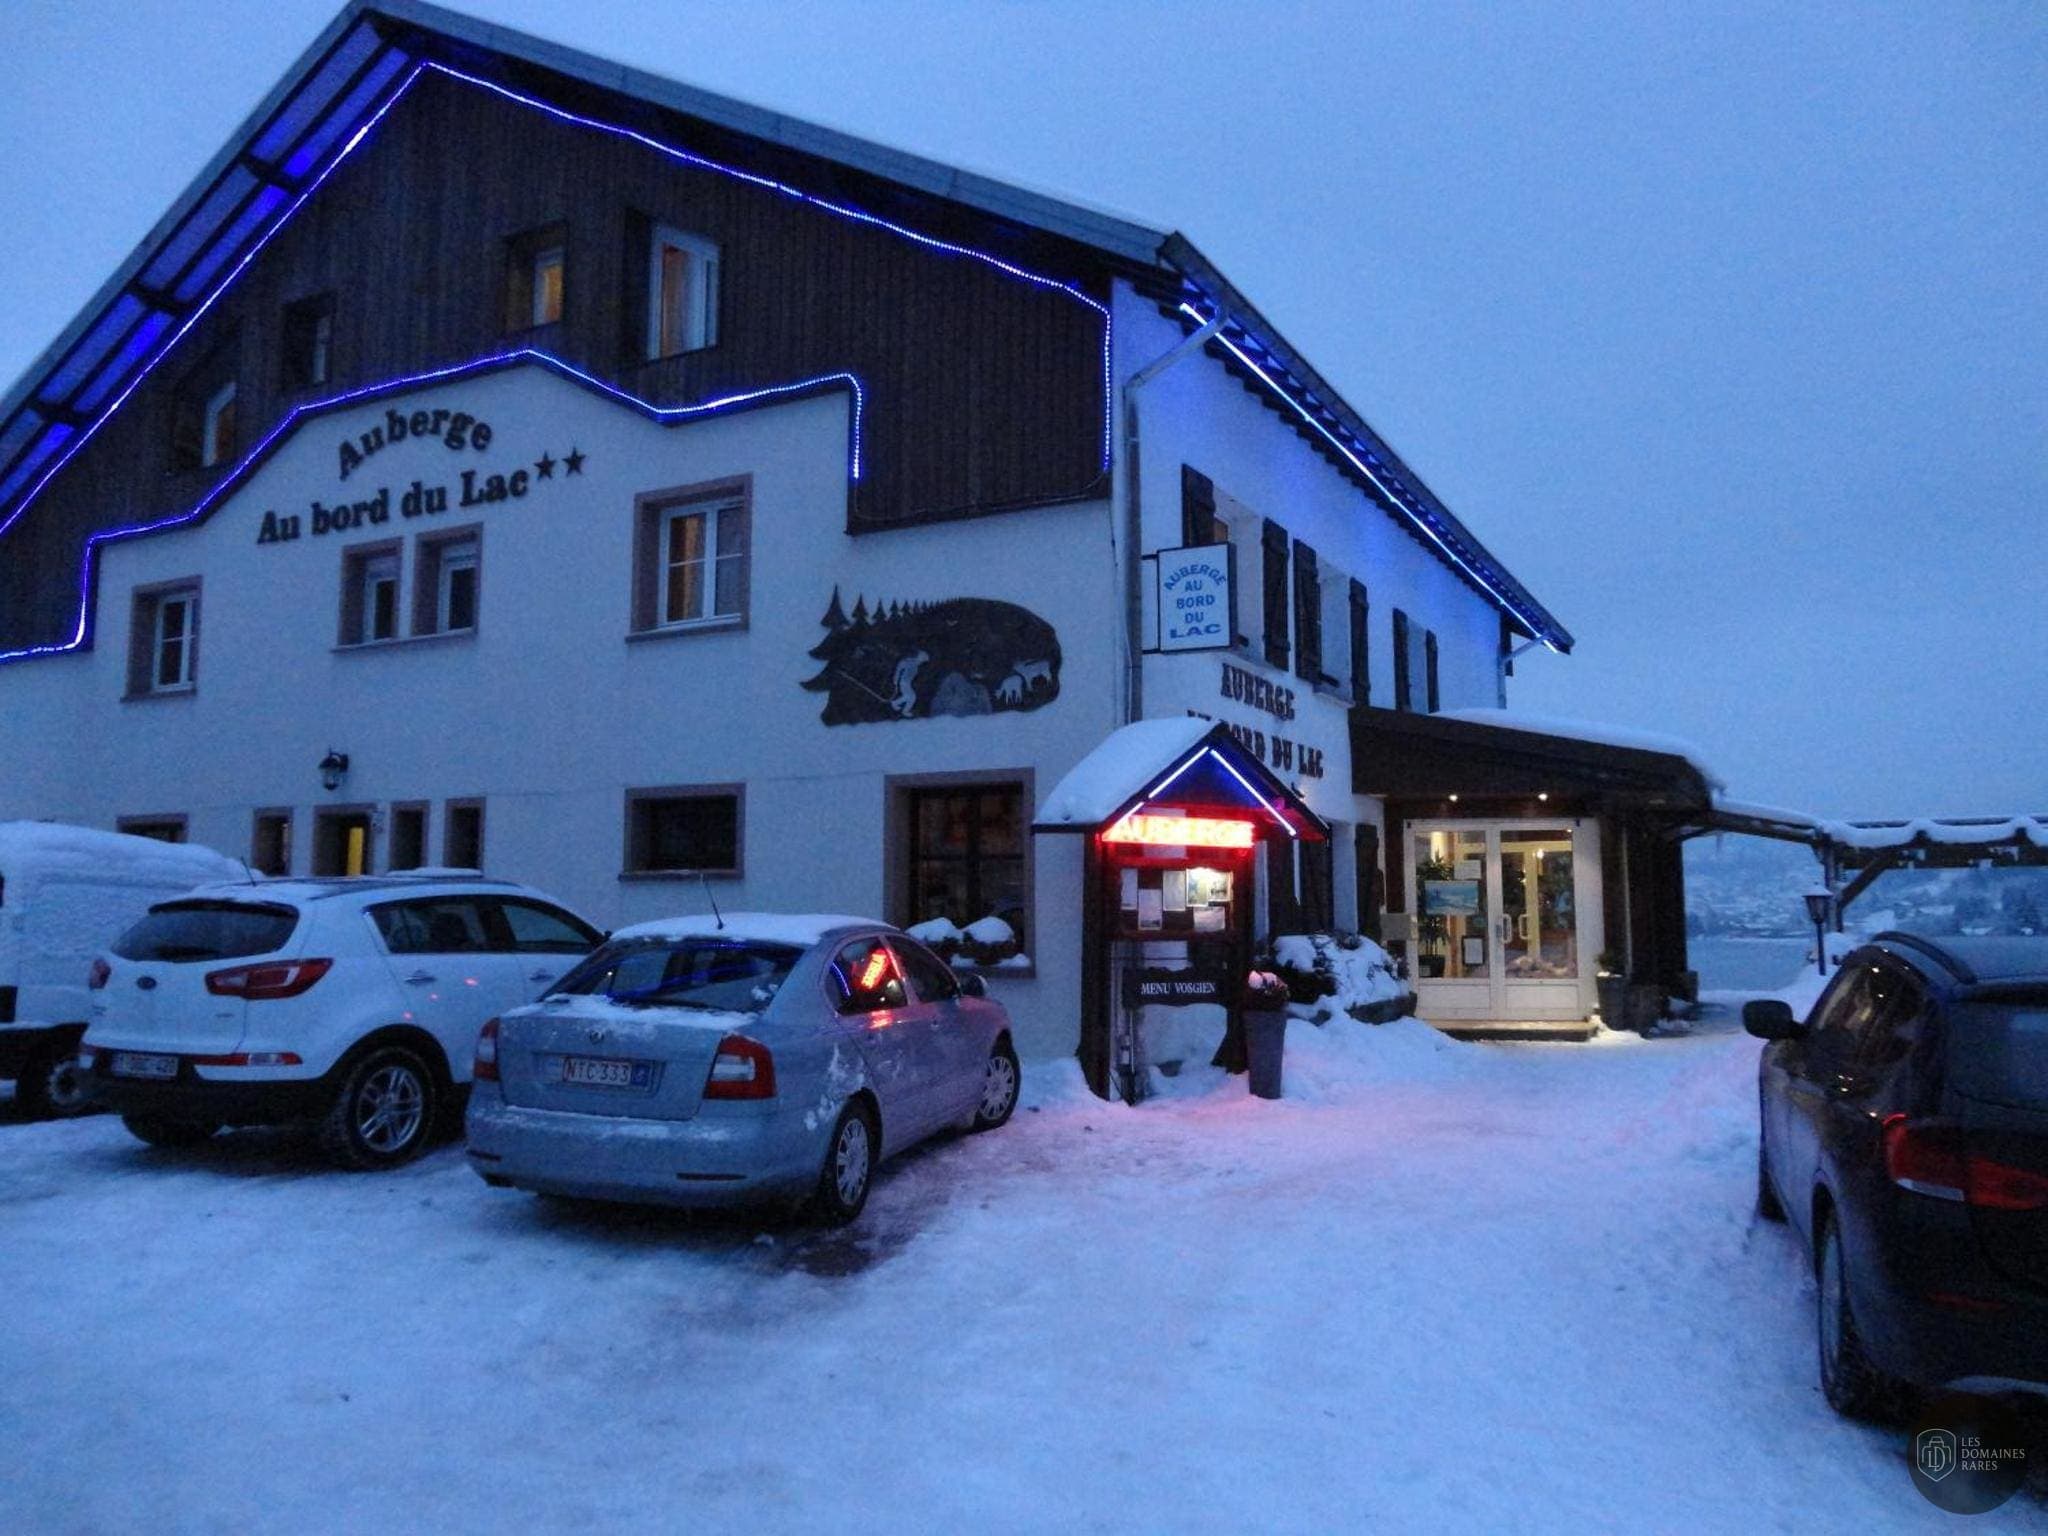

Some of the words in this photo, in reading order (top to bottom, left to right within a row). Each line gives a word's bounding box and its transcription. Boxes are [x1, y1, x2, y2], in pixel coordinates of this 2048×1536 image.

[338, 408, 493, 482] Auberge
[257, 510, 302, 544] Au
[310, 488, 390, 535] bord
[401, 481, 447, 518] du
[459, 468, 530, 507] Lac
[1164, 564, 1226, 590] AUBERGE
[1185, 580, 1202, 592] AU
[1176, 594, 1215, 609] BORD
[1185, 612, 1204, 624] DU
[1170, 624, 1222, 639] LAC
[1221, 662, 1295, 720] AUBERGE
[1222, 720, 1266, 763] RD
[1271, 735, 1293, 772] DU
[1298, 743, 1324, 778] LAC
[1141, 982, 1171, 995] MENU
[1174, 982, 1216, 994] VOSGIEN
